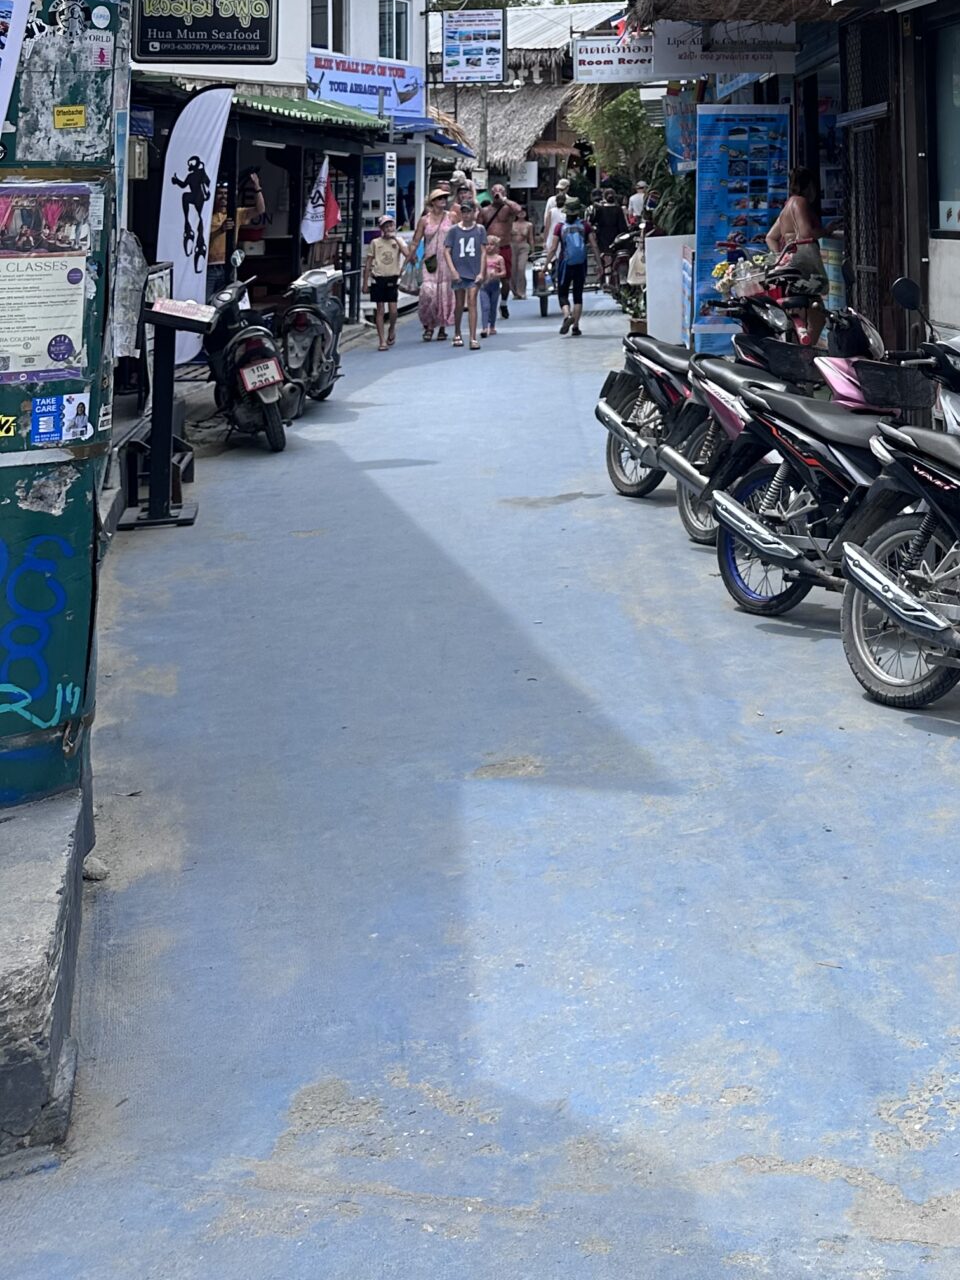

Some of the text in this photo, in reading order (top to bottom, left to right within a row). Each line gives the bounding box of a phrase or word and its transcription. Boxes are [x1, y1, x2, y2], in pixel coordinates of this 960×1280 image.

[147, 28, 260, 40] Hua Mum Seafood
[578, 58, 613, 66] Room
[458, 237, 476, 258] 14
[6, 260, 68, 273] CLASSES
[35, 397, 57, 406] TAKE
[35, 405, 57, 413] CARE
